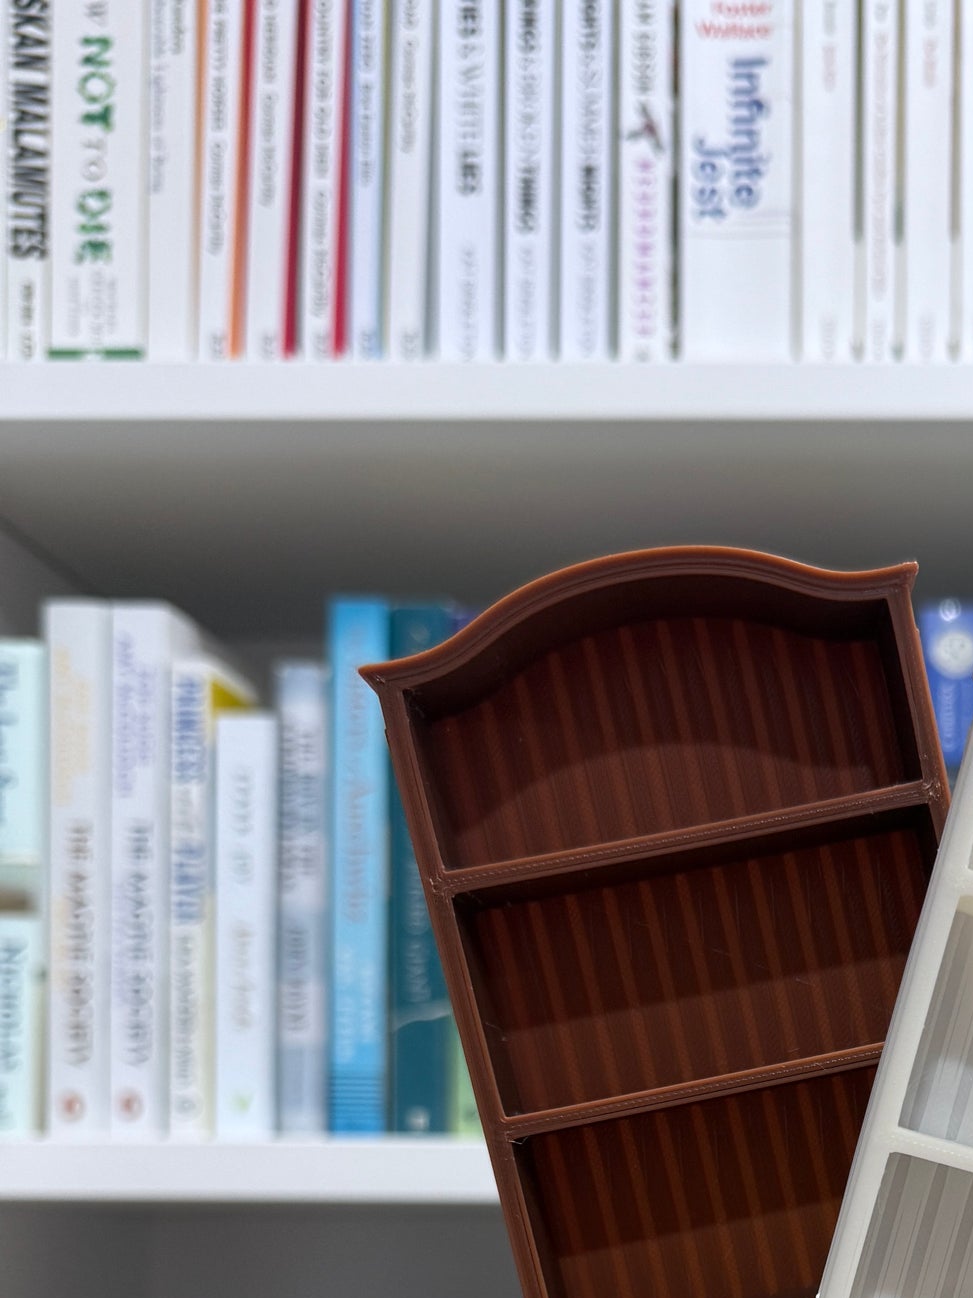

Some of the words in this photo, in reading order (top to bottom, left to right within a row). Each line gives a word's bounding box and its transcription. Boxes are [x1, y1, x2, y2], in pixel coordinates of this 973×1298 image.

[77, 35, 116, 132] NOT
[9, 82, 50, 261] MALAMUTES
[692, 134, 728, 221] Jest
[726, 57, 769, 211] Infinite
[74, 188, 113, 266] DIE
